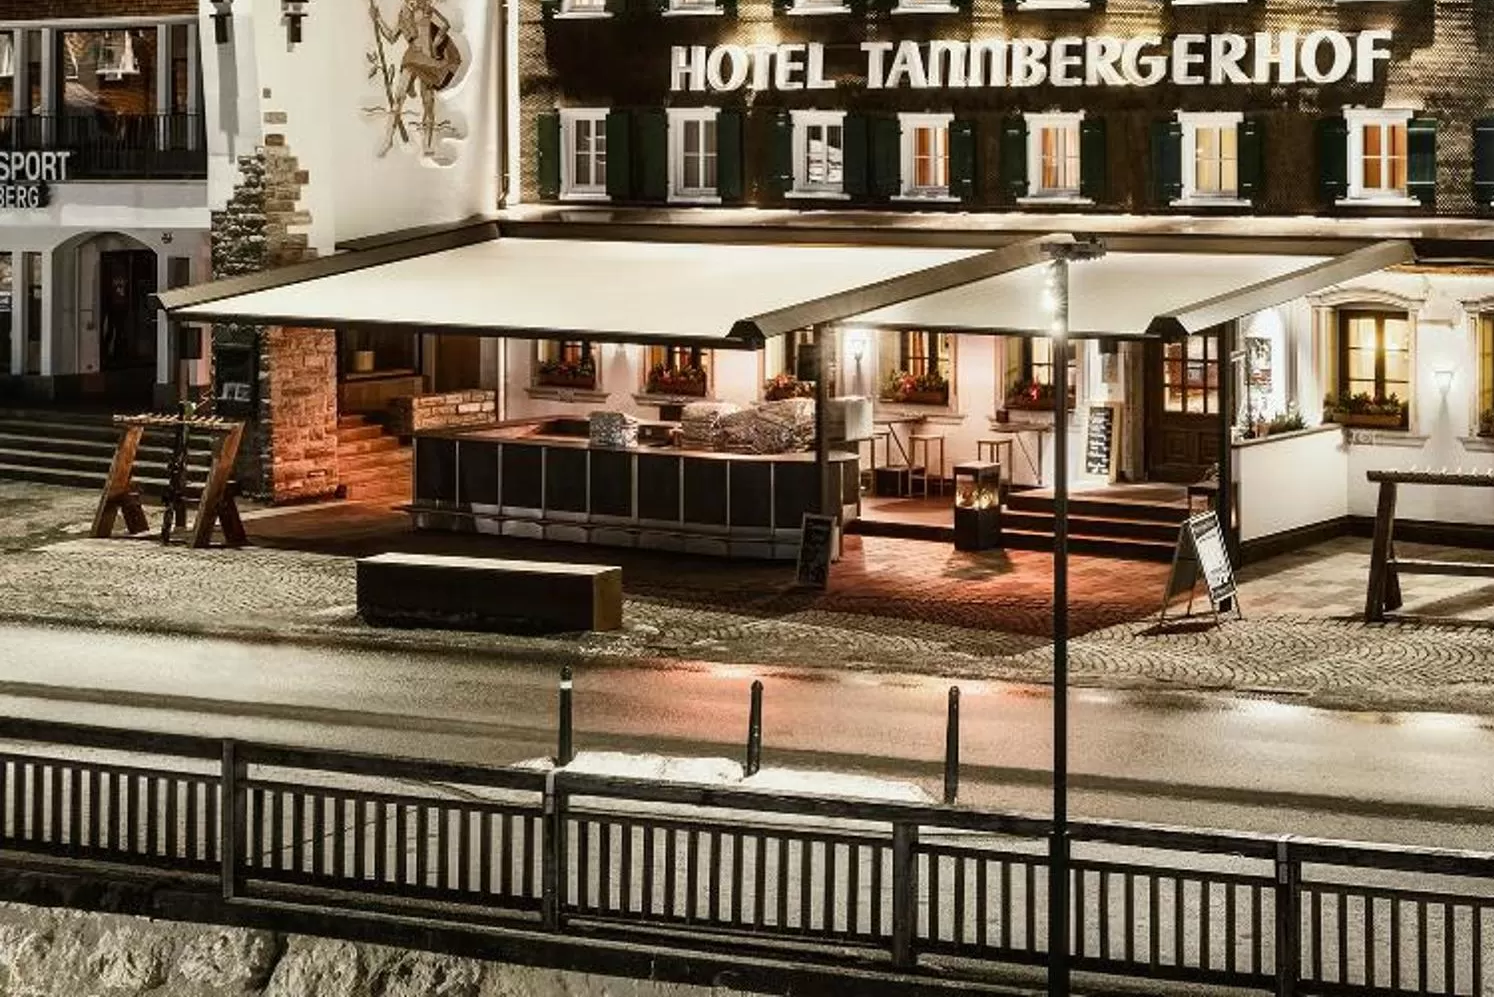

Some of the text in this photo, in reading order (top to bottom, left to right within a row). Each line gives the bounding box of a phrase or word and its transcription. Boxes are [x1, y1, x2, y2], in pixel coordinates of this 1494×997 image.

[670, 30, 1392, 92] HOTEL TANNBERGERHOF
[0, 151, 70, 181] SPORT
